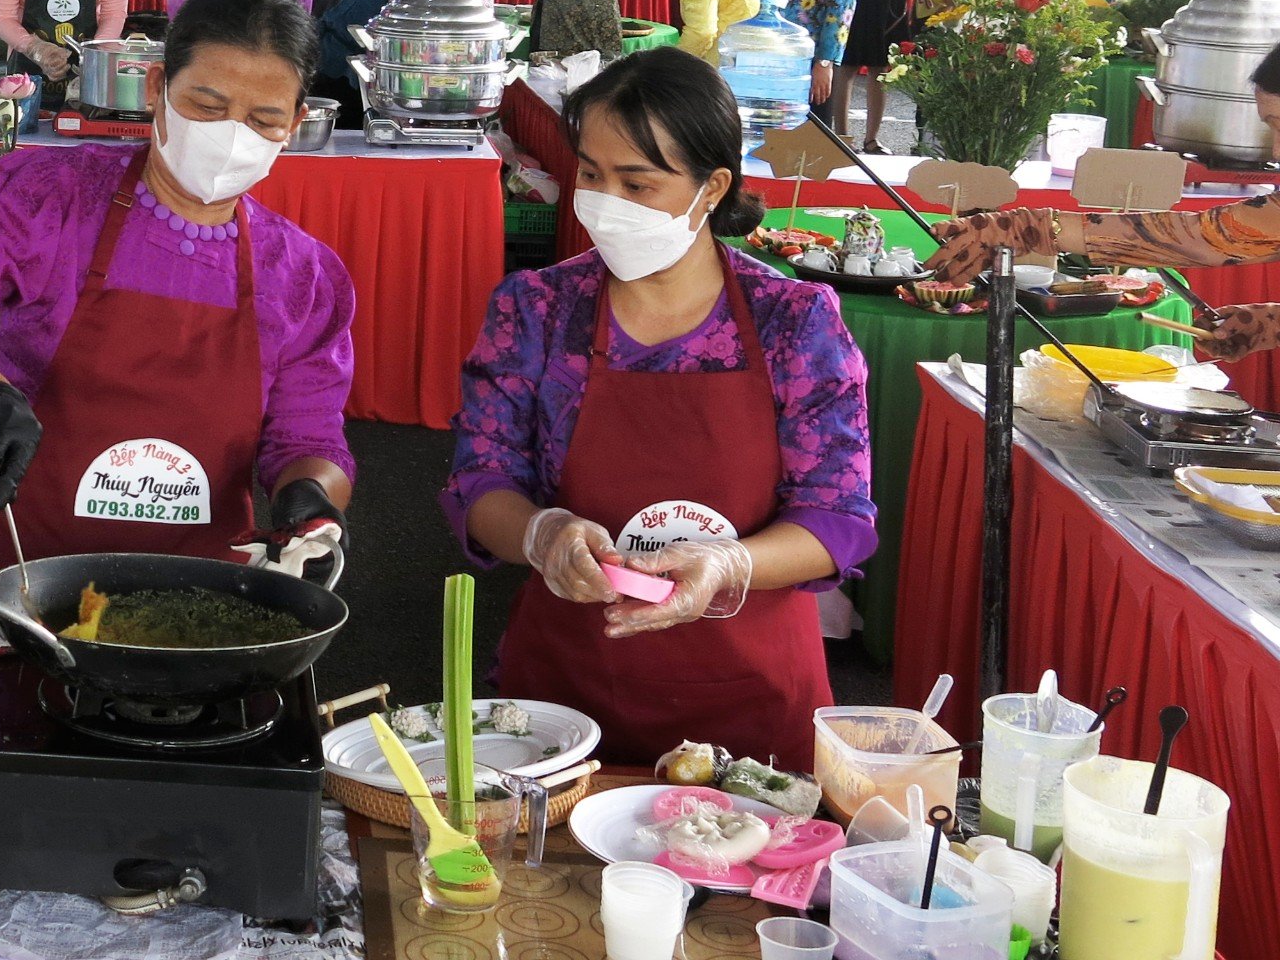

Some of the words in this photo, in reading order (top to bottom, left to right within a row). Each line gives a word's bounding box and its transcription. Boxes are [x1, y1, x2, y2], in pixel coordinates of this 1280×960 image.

[109, 444, 137, 467] Bếp
[142, 443, 184, 474] Nàng
[91, 471, 139, 498] Thúy
[138, 476, 200, 503] Nguyễn
[86, 499, 200, 521] 0793.832.789
[640, 506, 669, 528] Bếp
[672, 505, 717, 535] Nàng
[470, 863, 488, 873] 200
